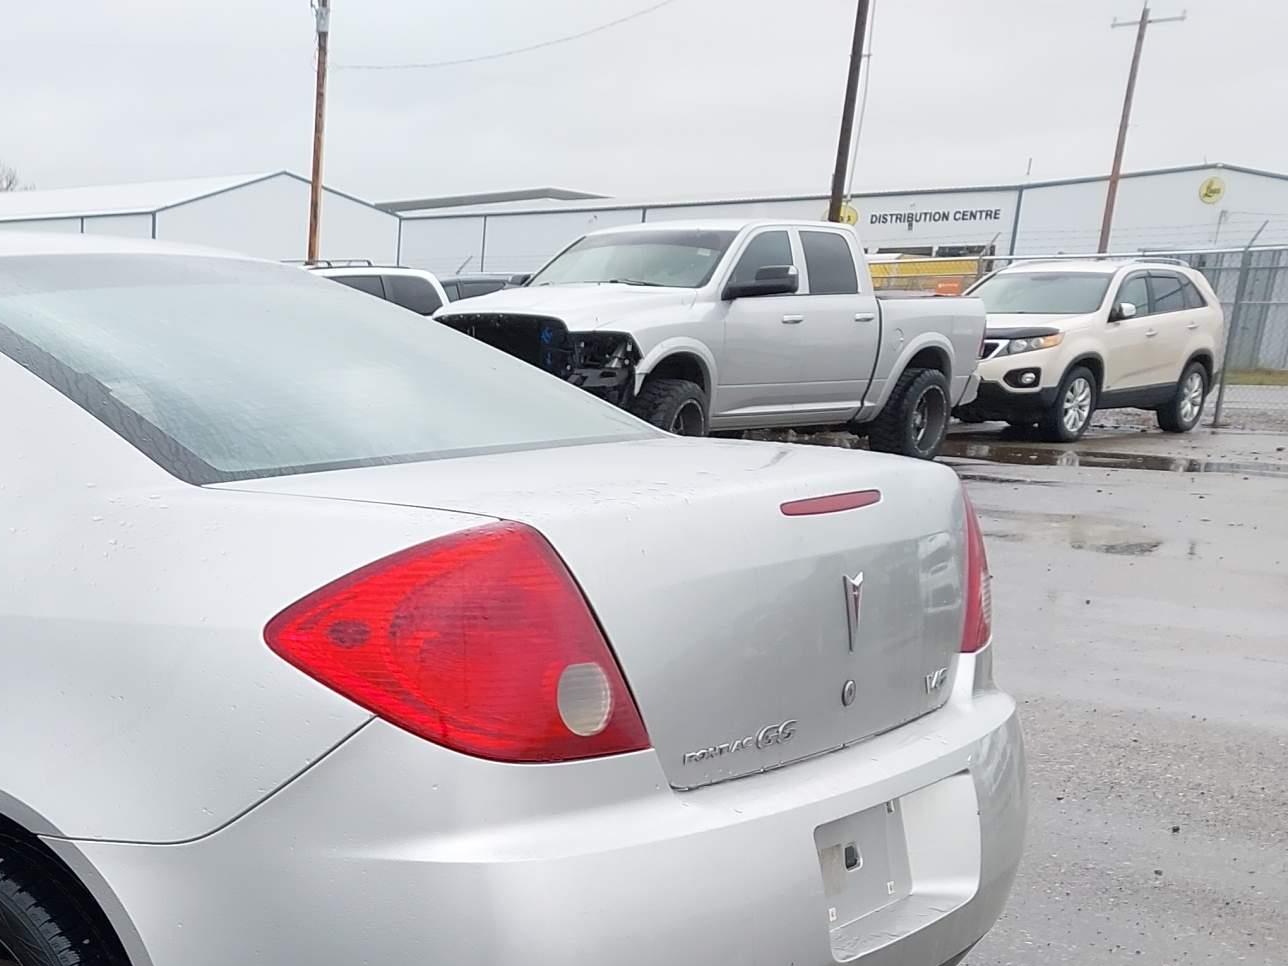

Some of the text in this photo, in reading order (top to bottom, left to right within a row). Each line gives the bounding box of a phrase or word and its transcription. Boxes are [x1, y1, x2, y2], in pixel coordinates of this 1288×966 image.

[870, 209, 1001, 225] DISTRIBUTION CENTRE
[683, 737, 754, 767] PONTIAC
